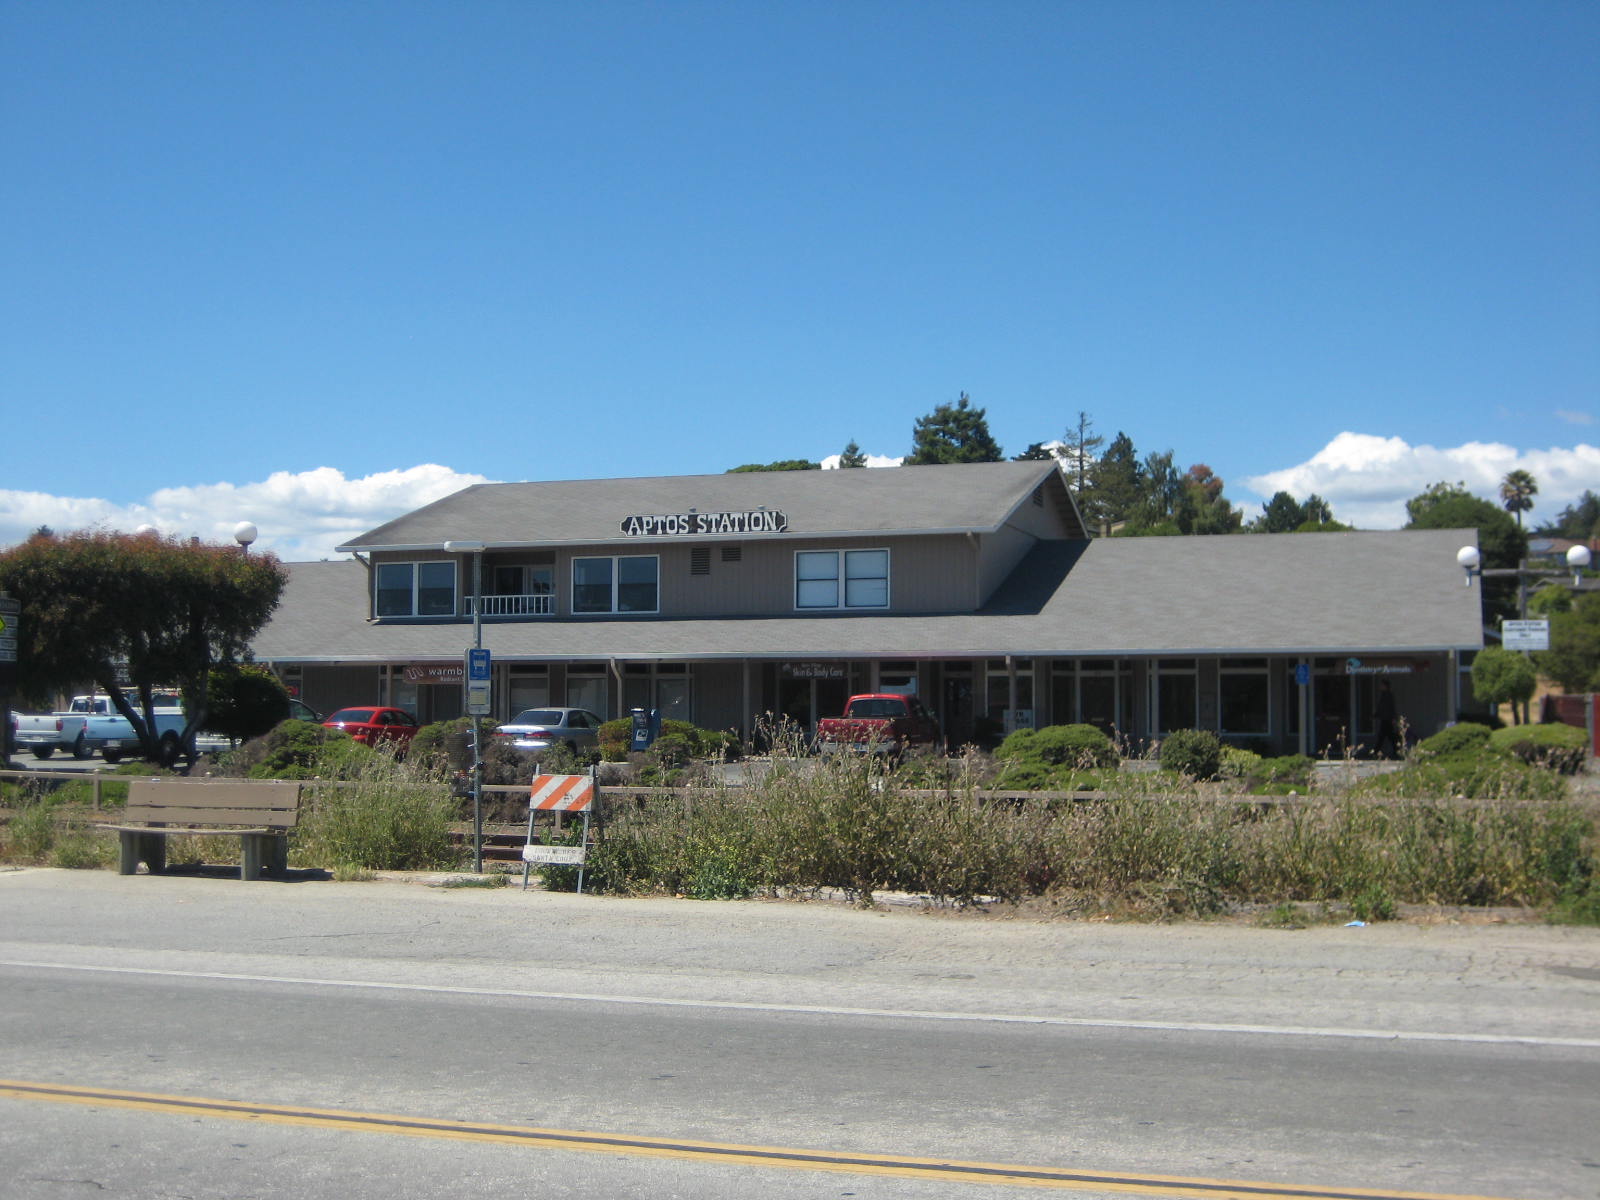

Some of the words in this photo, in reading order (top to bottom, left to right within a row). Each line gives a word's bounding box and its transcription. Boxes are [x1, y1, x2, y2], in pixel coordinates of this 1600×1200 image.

[627, 514, 689, 536] APTOS
[696, 511, 777, 534] STATION
[428, 666, 464, 676] warmb
